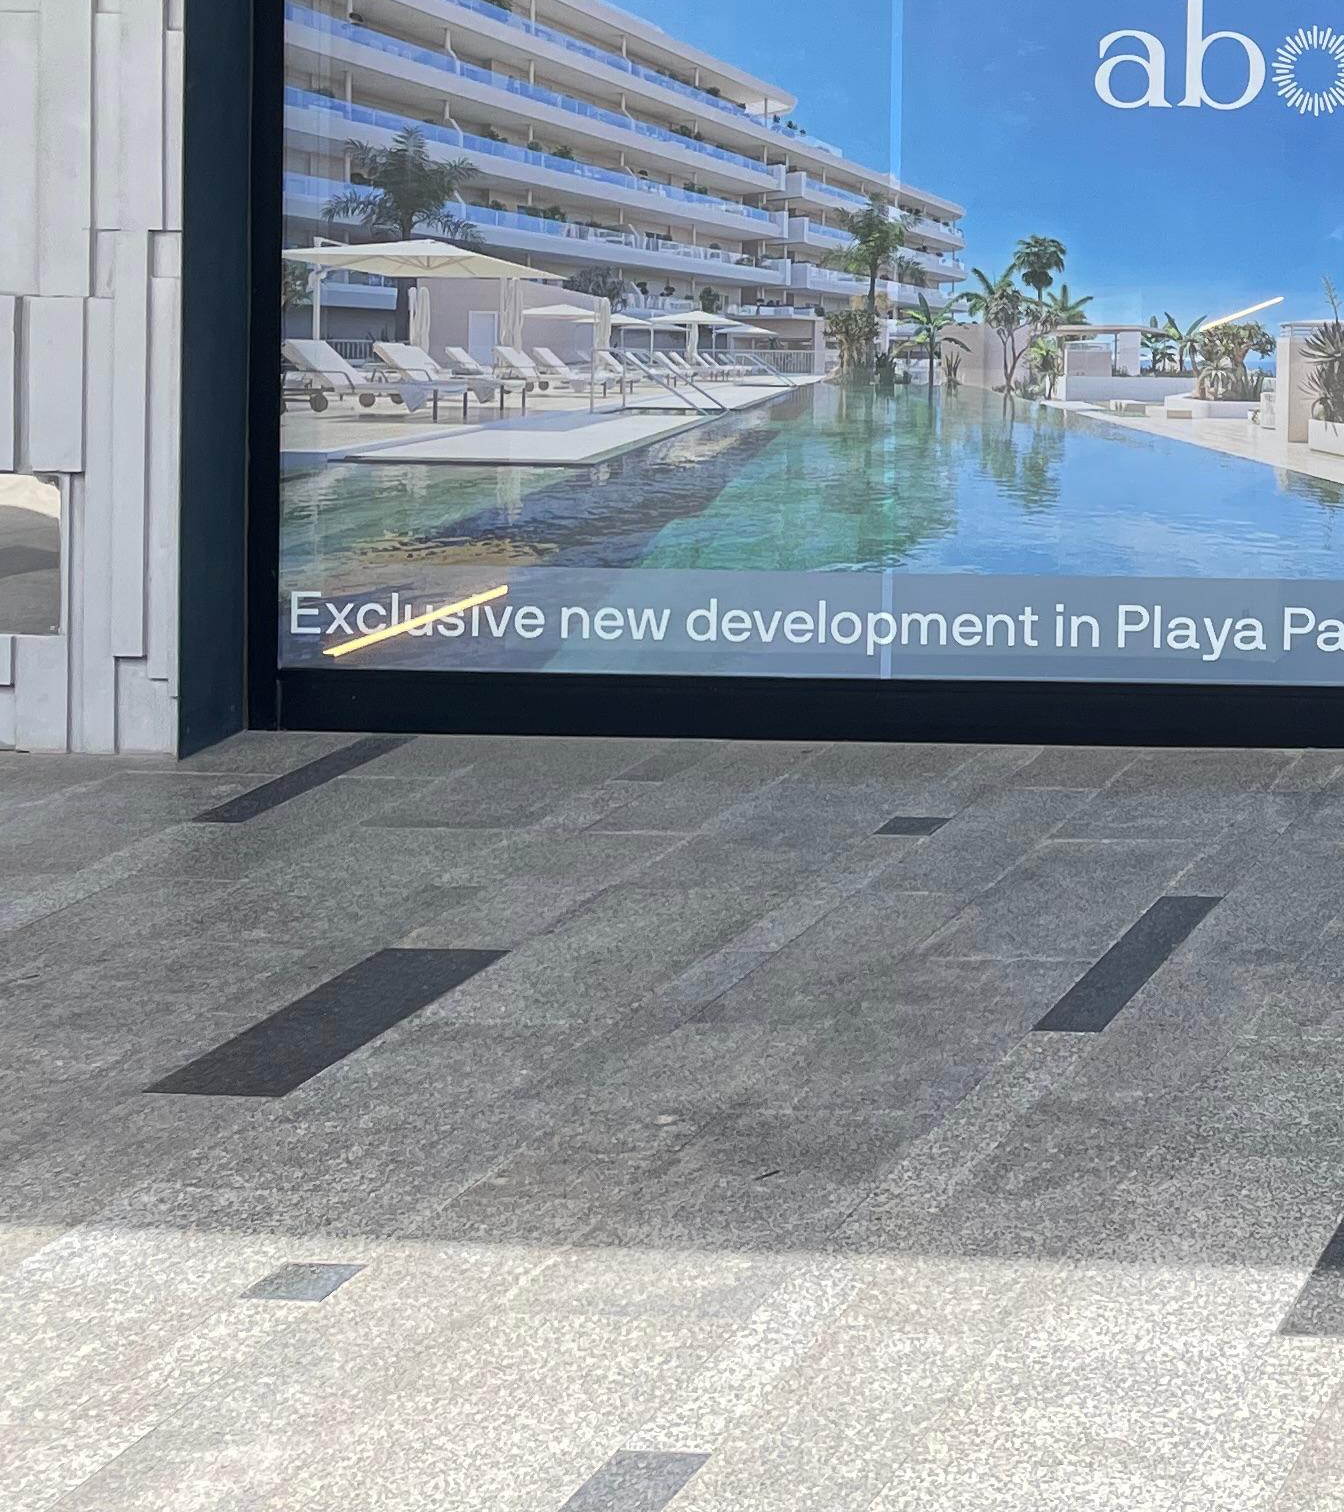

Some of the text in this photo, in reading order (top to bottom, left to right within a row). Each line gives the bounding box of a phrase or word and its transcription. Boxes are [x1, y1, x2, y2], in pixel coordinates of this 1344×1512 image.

[289, 591, 545, 639] Exclusive
[560, 606, 671, 641] new
[686, 598, 1039, 656] development
[1055, 603, 1100, 648] in
[1117, 604, 1267, 661] Playa
